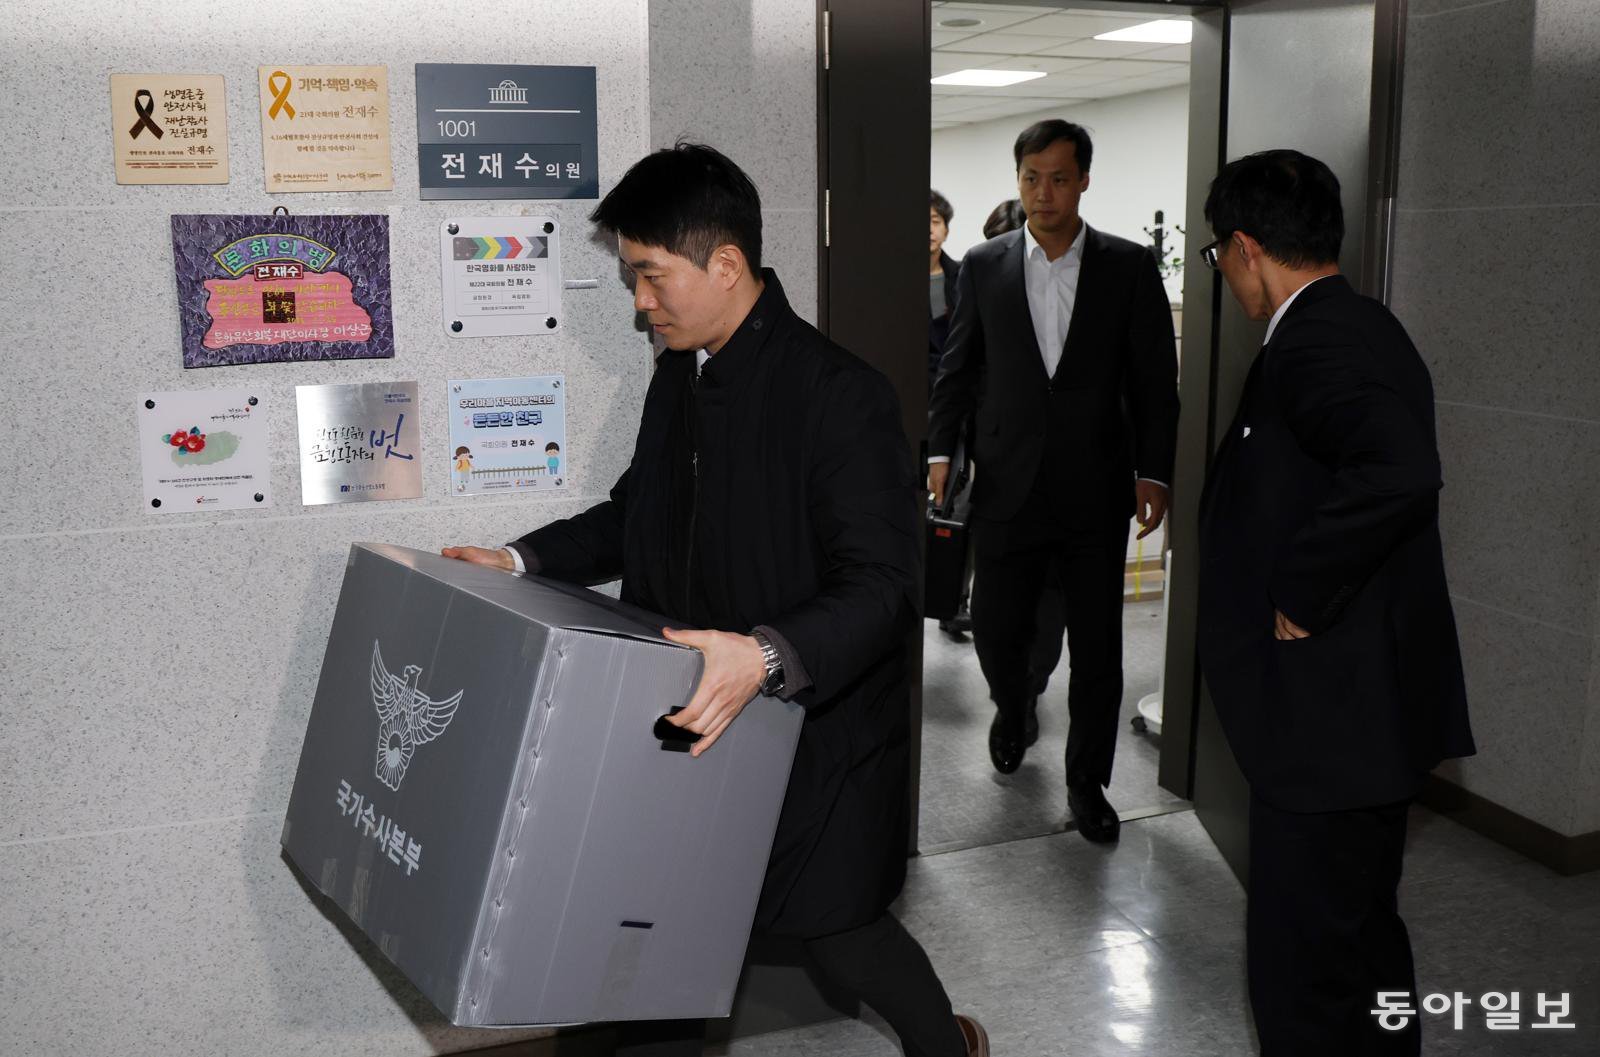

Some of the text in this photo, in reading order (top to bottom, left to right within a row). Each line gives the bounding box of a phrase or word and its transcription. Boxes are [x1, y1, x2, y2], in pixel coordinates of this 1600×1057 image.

[163, 101, 207, 113] 안전사회
[342, 105, 379, 118] 전재수
[437, 120, 476, 137] 1001
[187, 145, 215, 155] 전재수
[441, 152, 581, 179] 전재수 의원
[257, 267, 300, 278] 전재수
[466, 263, 536, 273] 한국영화를 사랑하는
[333, 323, 372, 337] 이상근
[473, 410, 542, 428] 든든한 친구
[370, 413, 413, 459] 벗
[512, 440, 535, 448] 전재수
[336, 778, 422, 876] 국가수사본부
